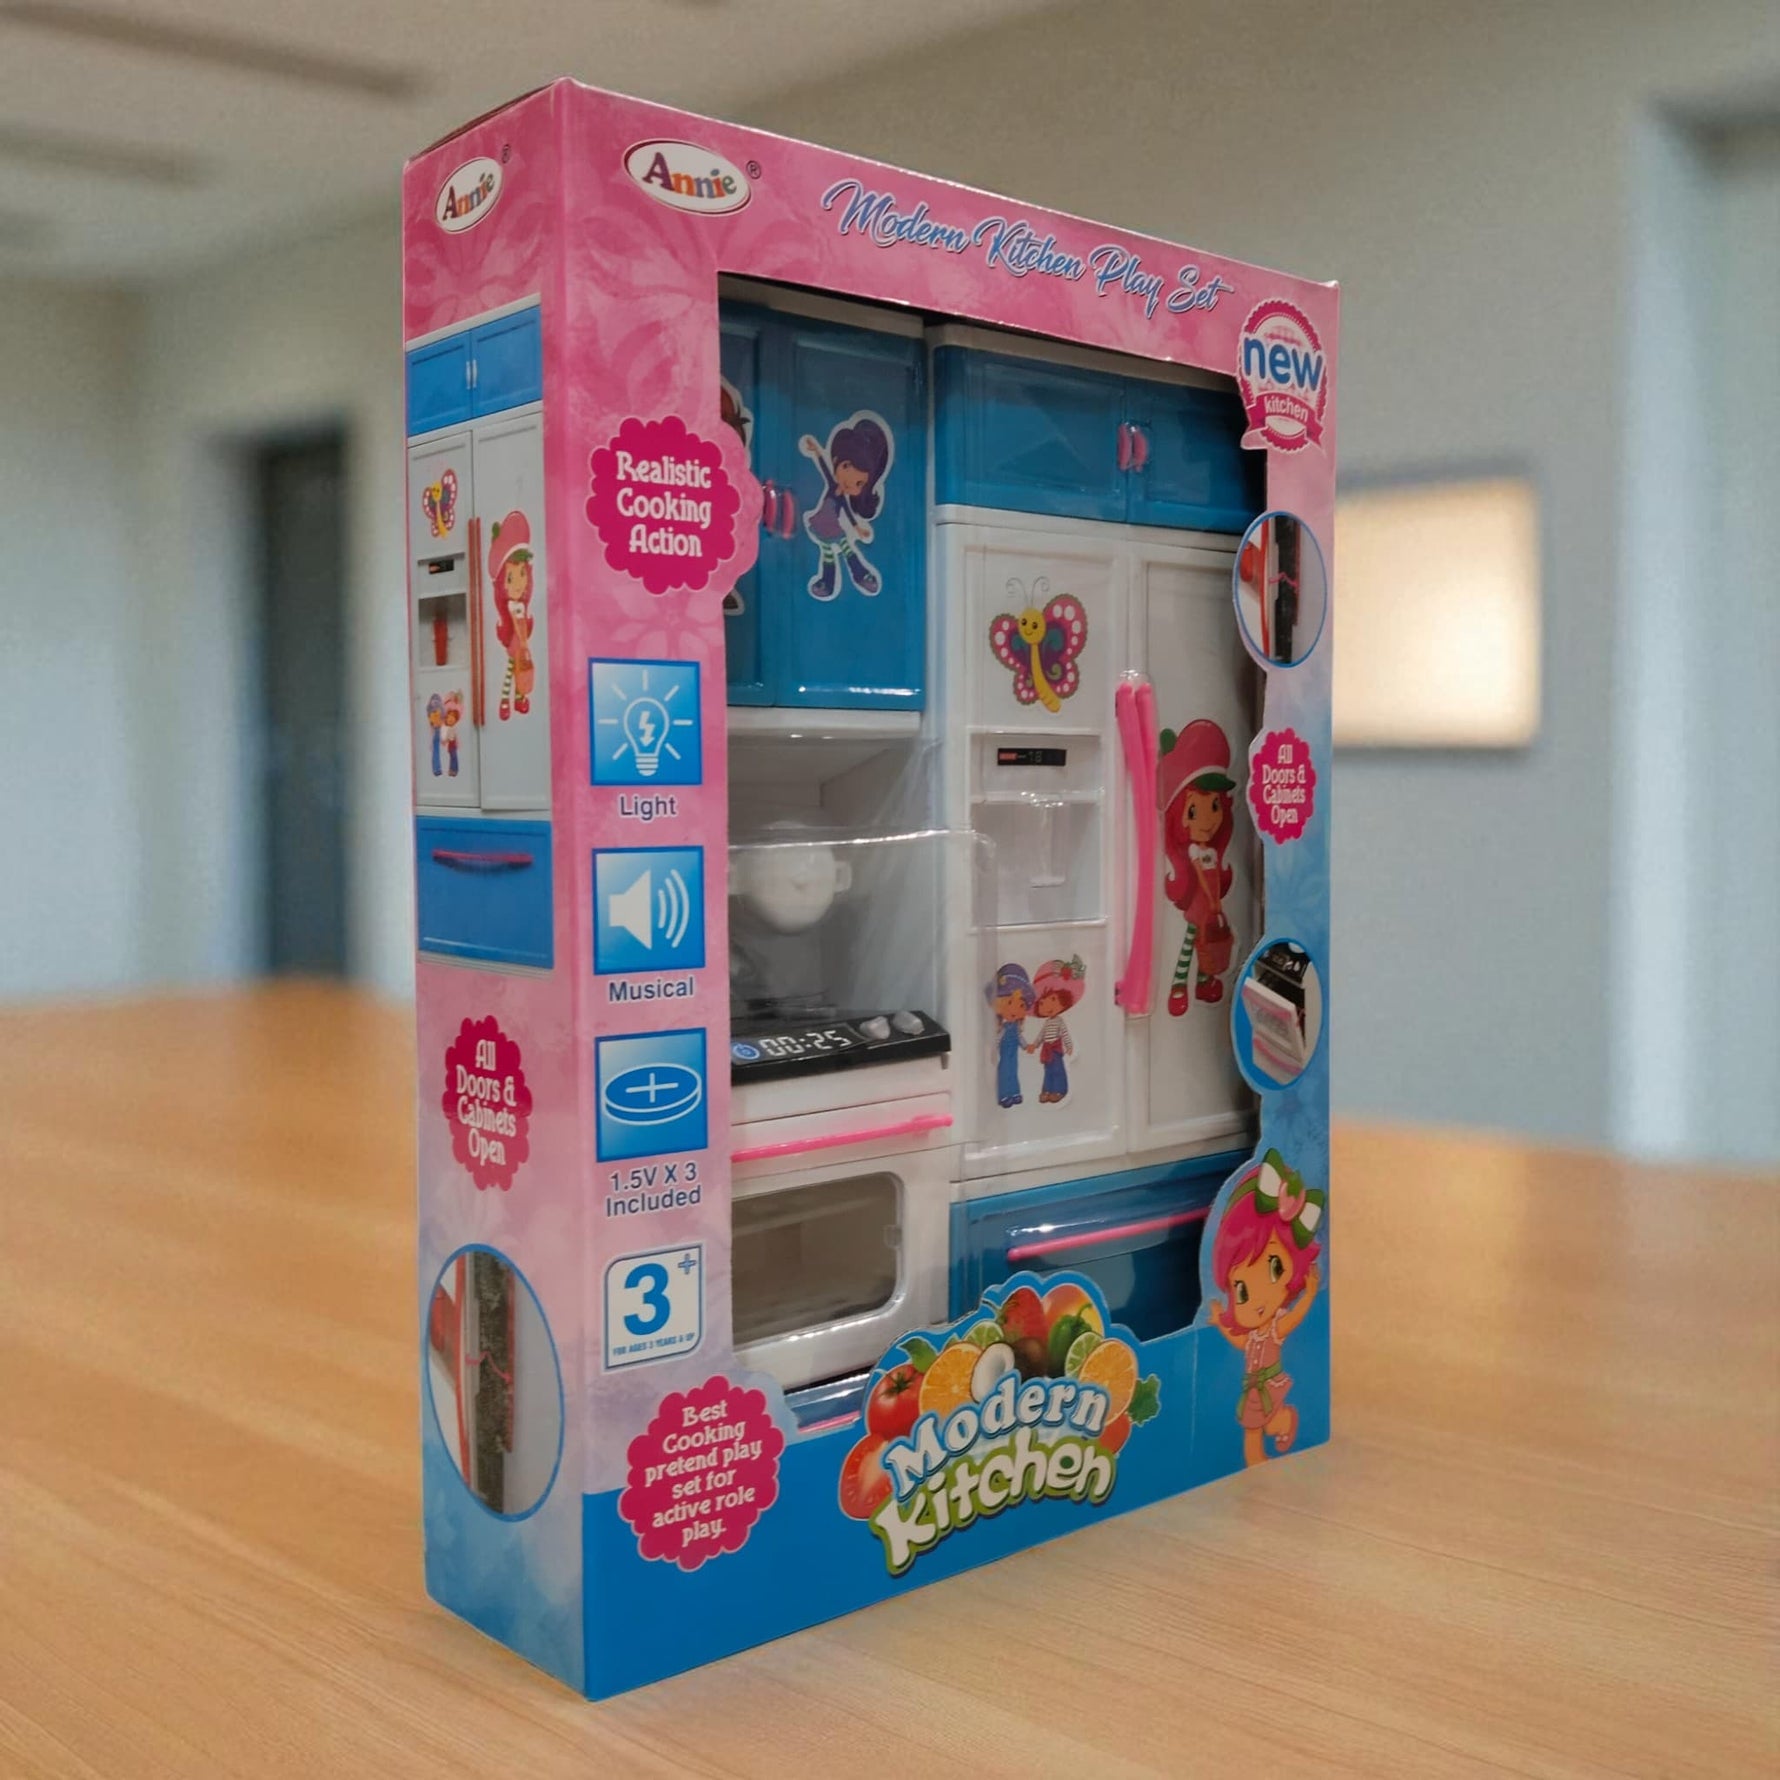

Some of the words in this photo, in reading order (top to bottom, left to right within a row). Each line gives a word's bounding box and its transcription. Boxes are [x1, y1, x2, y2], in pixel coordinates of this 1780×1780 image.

[642, 151, 737, 199] Annie
[442, 172, 495, 221] Annie
[821, 179, 970, 254] Modern
[974, 216, 1086, 281] Kitchen
[1090, 245, 1163, 318] Play
[1167, 265, 1234, 315] Set
[1243, 336, 1323, 392] new
[1264, 396, 1308, 422] kitchen
[616, 450, 712, 489] Realistic
[616, 487, 712, 530] Cooking
[629, 524, 703, 557] Action
[1277, 744, 1293, 764] All
[1262, 764, 1295, 784] Doors
[619, 796, 677, 821] Light
[1271, 804, 1299, 828] Open
[609, 977, 694, 1002] Musical
[475, 1039, 497, 1071] All
[759, 1030, 852, 1057] 00:25
[456, 1064, 500, 1102] Doors
[457, 1095, 517, 1138] Cabinets
[468, 1127, 506, 1166] Open
[611, 1166, 658, 1191] 1.5V
[664, 1164, 677, 1184] X
[685, 1162, 697, 1182] 3
[606, 1185, 702, 1217] Included
[682, 1400, 728, 1427] Best
[662, 1421, 747, 1454] Cooking
[884, 1374, 1110, 1497] Modern
[644, 1446, 718, 1488] pretend
[722, 1440, 763, 1467] play
[671, 1473, 702, 1499] set
[705, 1469, 737, 1491] for
[873, 1426, 1113, 1570] Kitchen
[652, 1500, 711, 1528] active
[715, 1486, 756, 1511] role
